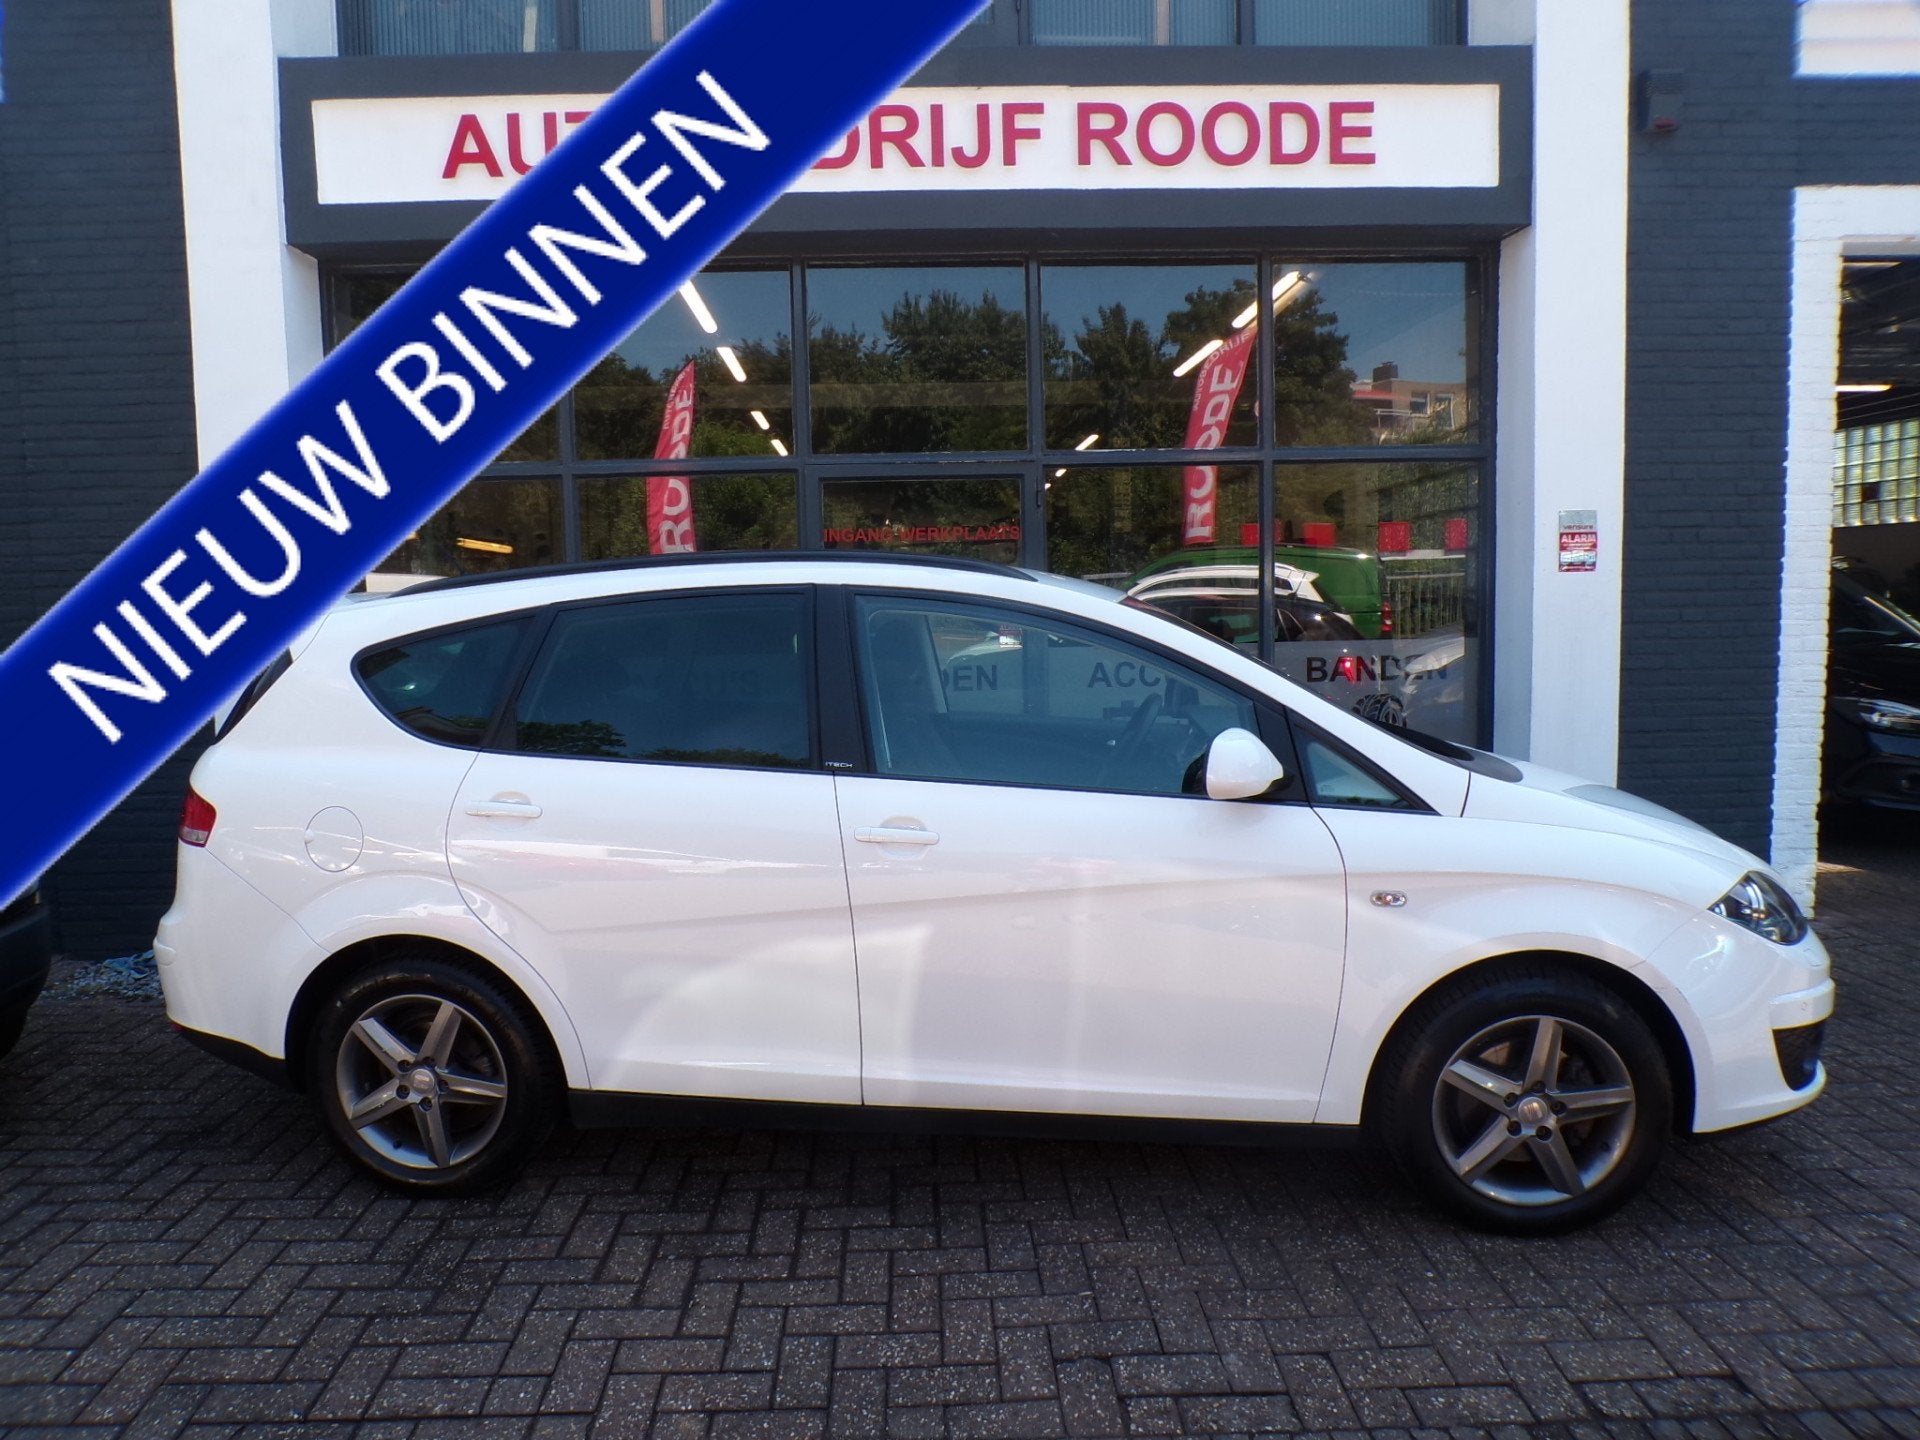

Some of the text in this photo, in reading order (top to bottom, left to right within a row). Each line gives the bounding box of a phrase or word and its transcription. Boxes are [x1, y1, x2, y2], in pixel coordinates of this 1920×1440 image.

[1078, 101, 1376, 165] ROODE
[823, 525, 1021, 543] INGANG WERKPLAATS
[1561, 533, 1597, 543] ALARM
